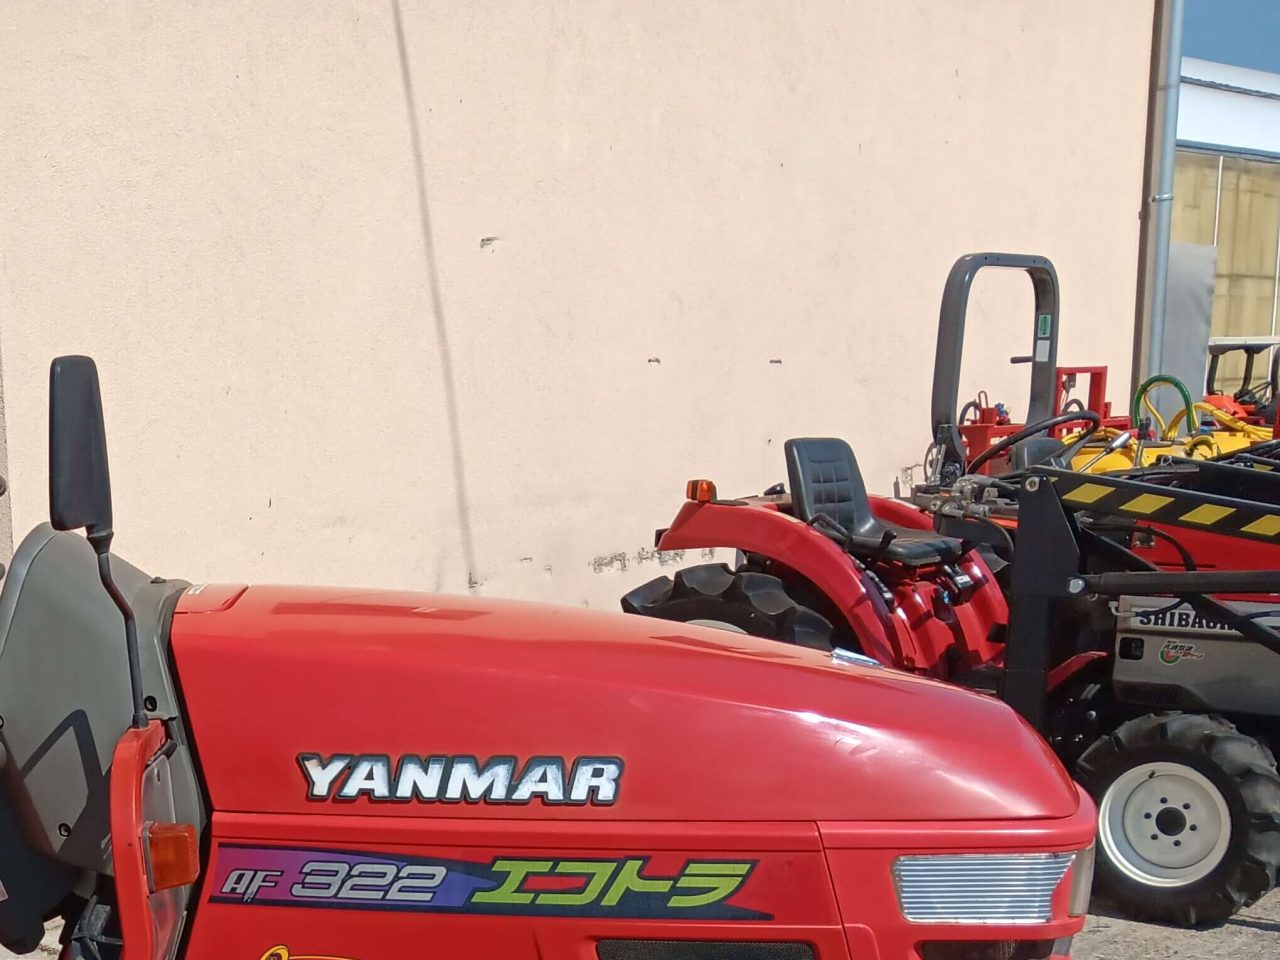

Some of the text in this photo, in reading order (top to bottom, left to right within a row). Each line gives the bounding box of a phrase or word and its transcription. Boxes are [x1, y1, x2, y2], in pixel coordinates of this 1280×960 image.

[297, 753, 624, 805] YANMAR
[220, 860, 752, 907] AF 322 エコトラ
